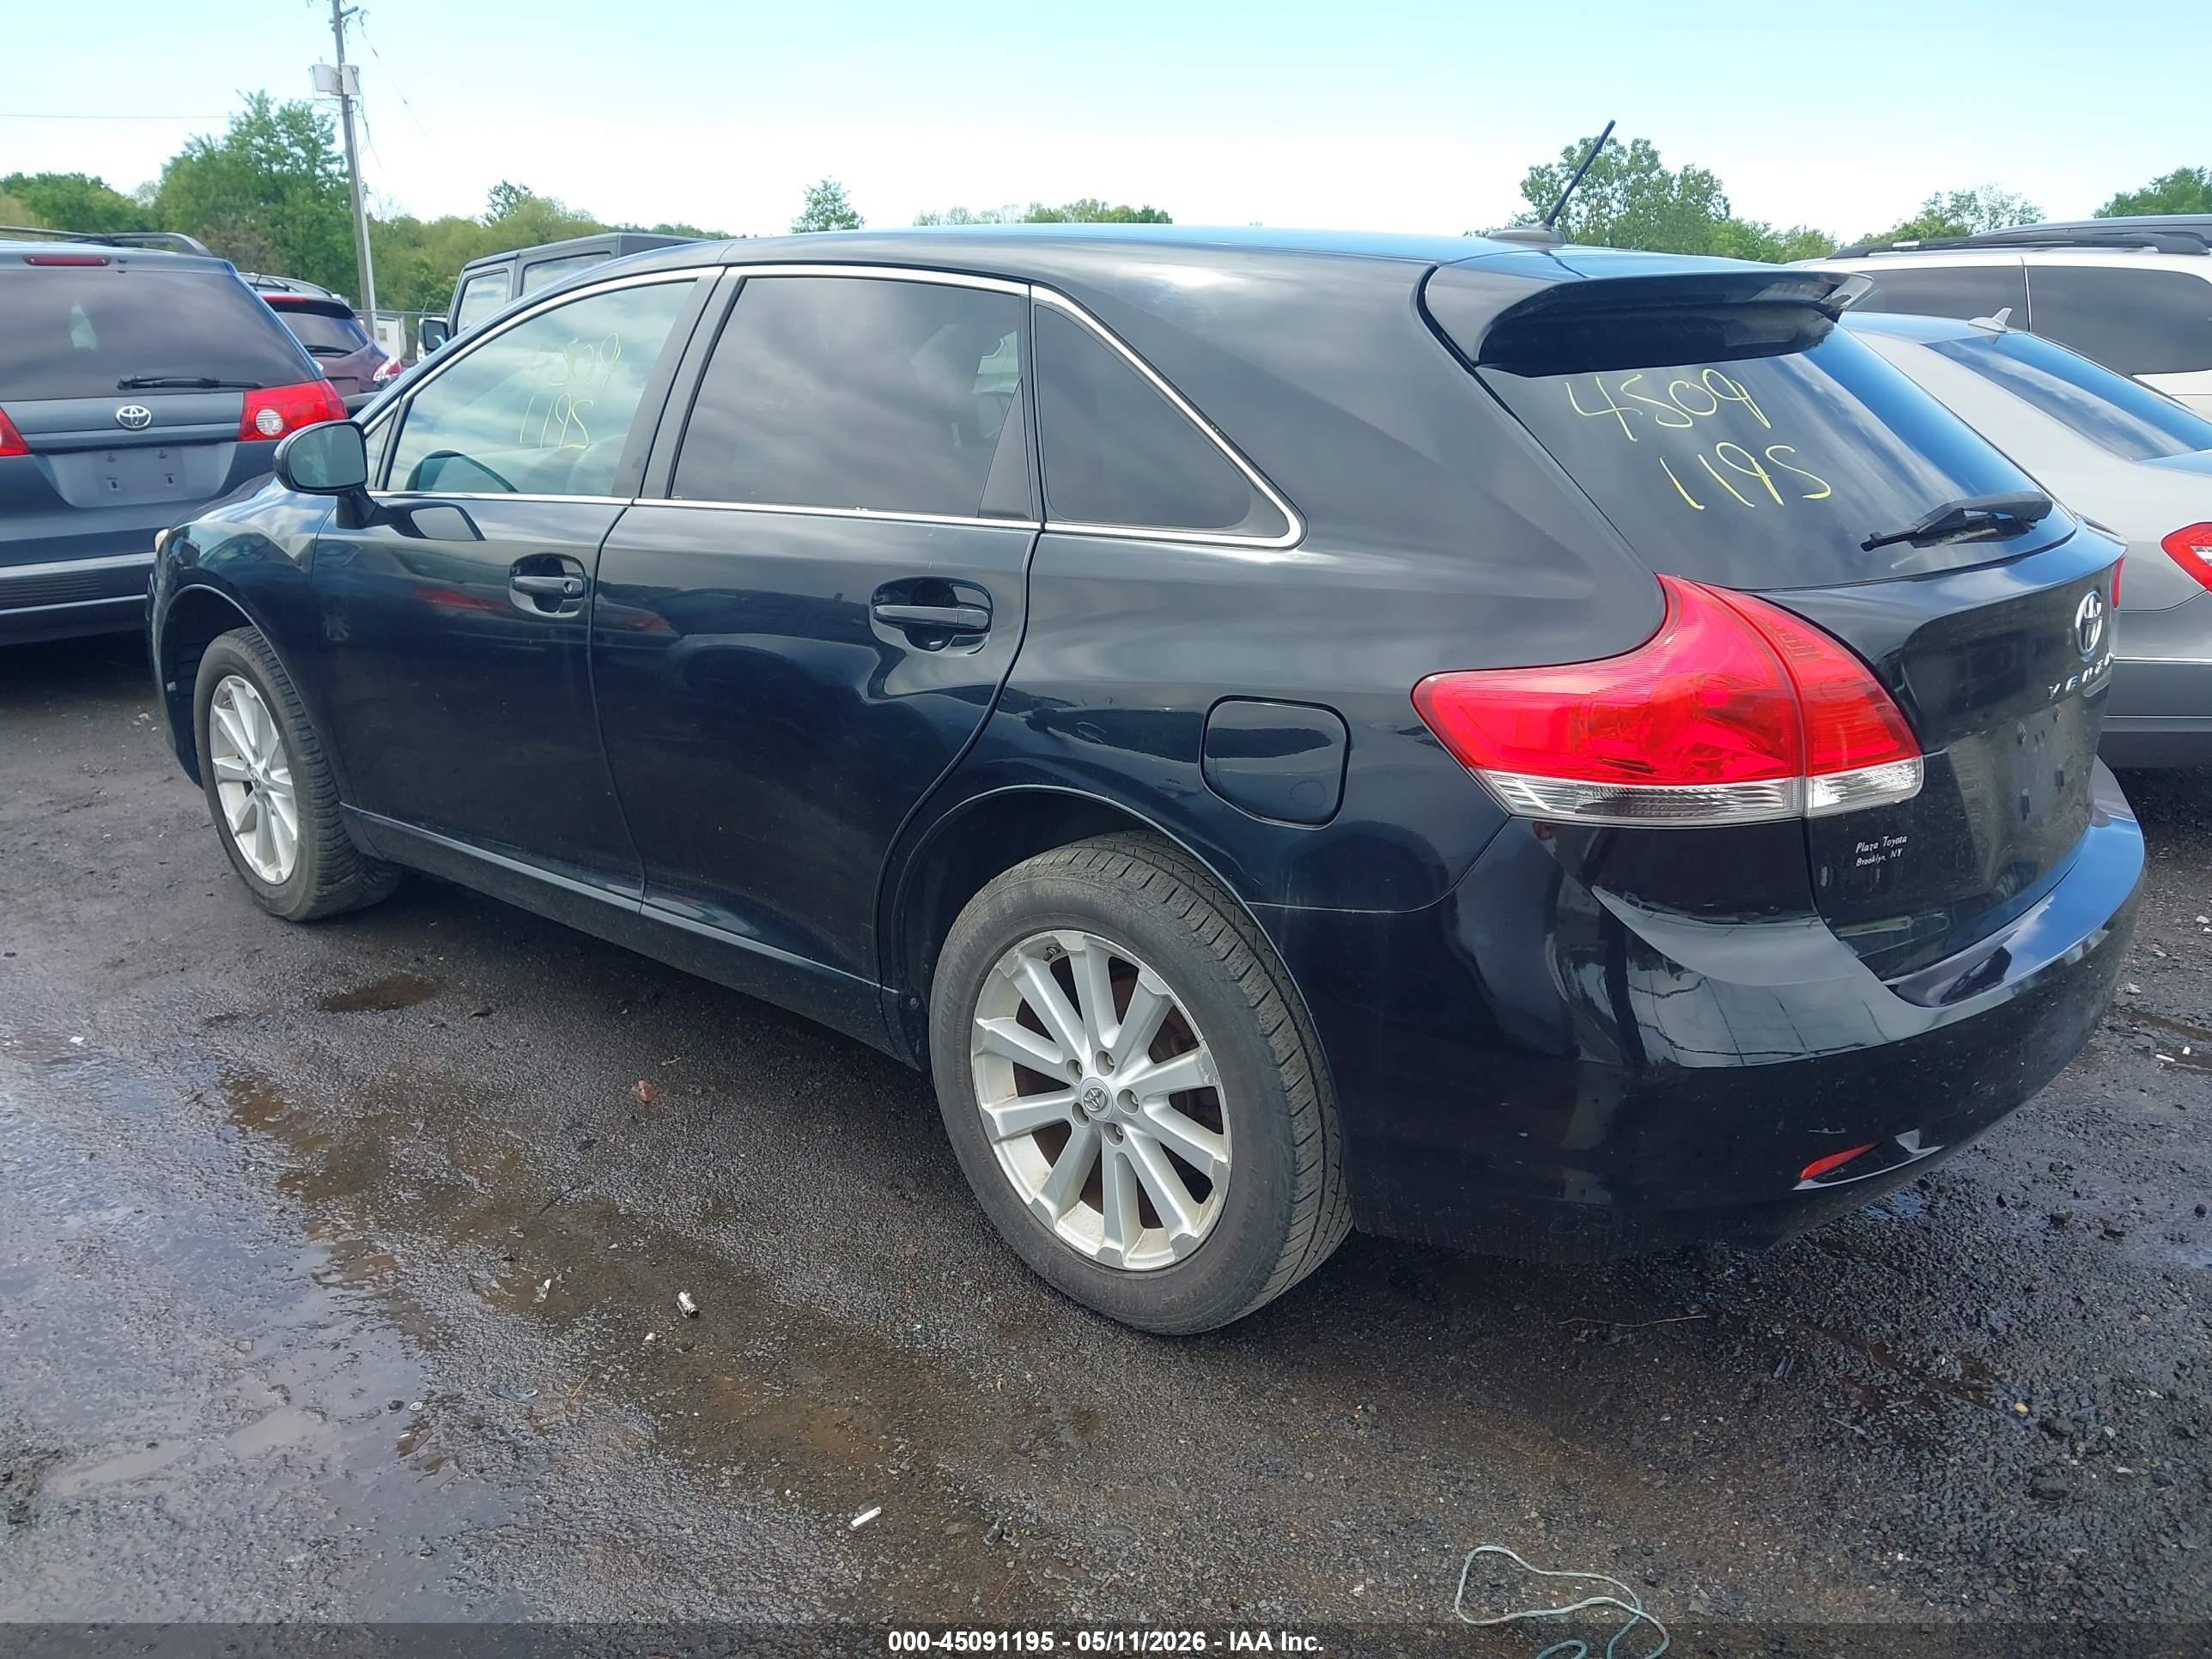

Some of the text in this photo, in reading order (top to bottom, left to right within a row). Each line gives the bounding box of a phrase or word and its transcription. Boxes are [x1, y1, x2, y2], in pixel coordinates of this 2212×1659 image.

[1856, 836, 1908, 854] Plaza Toyota
[1890, 848, 1903, 859] NY
